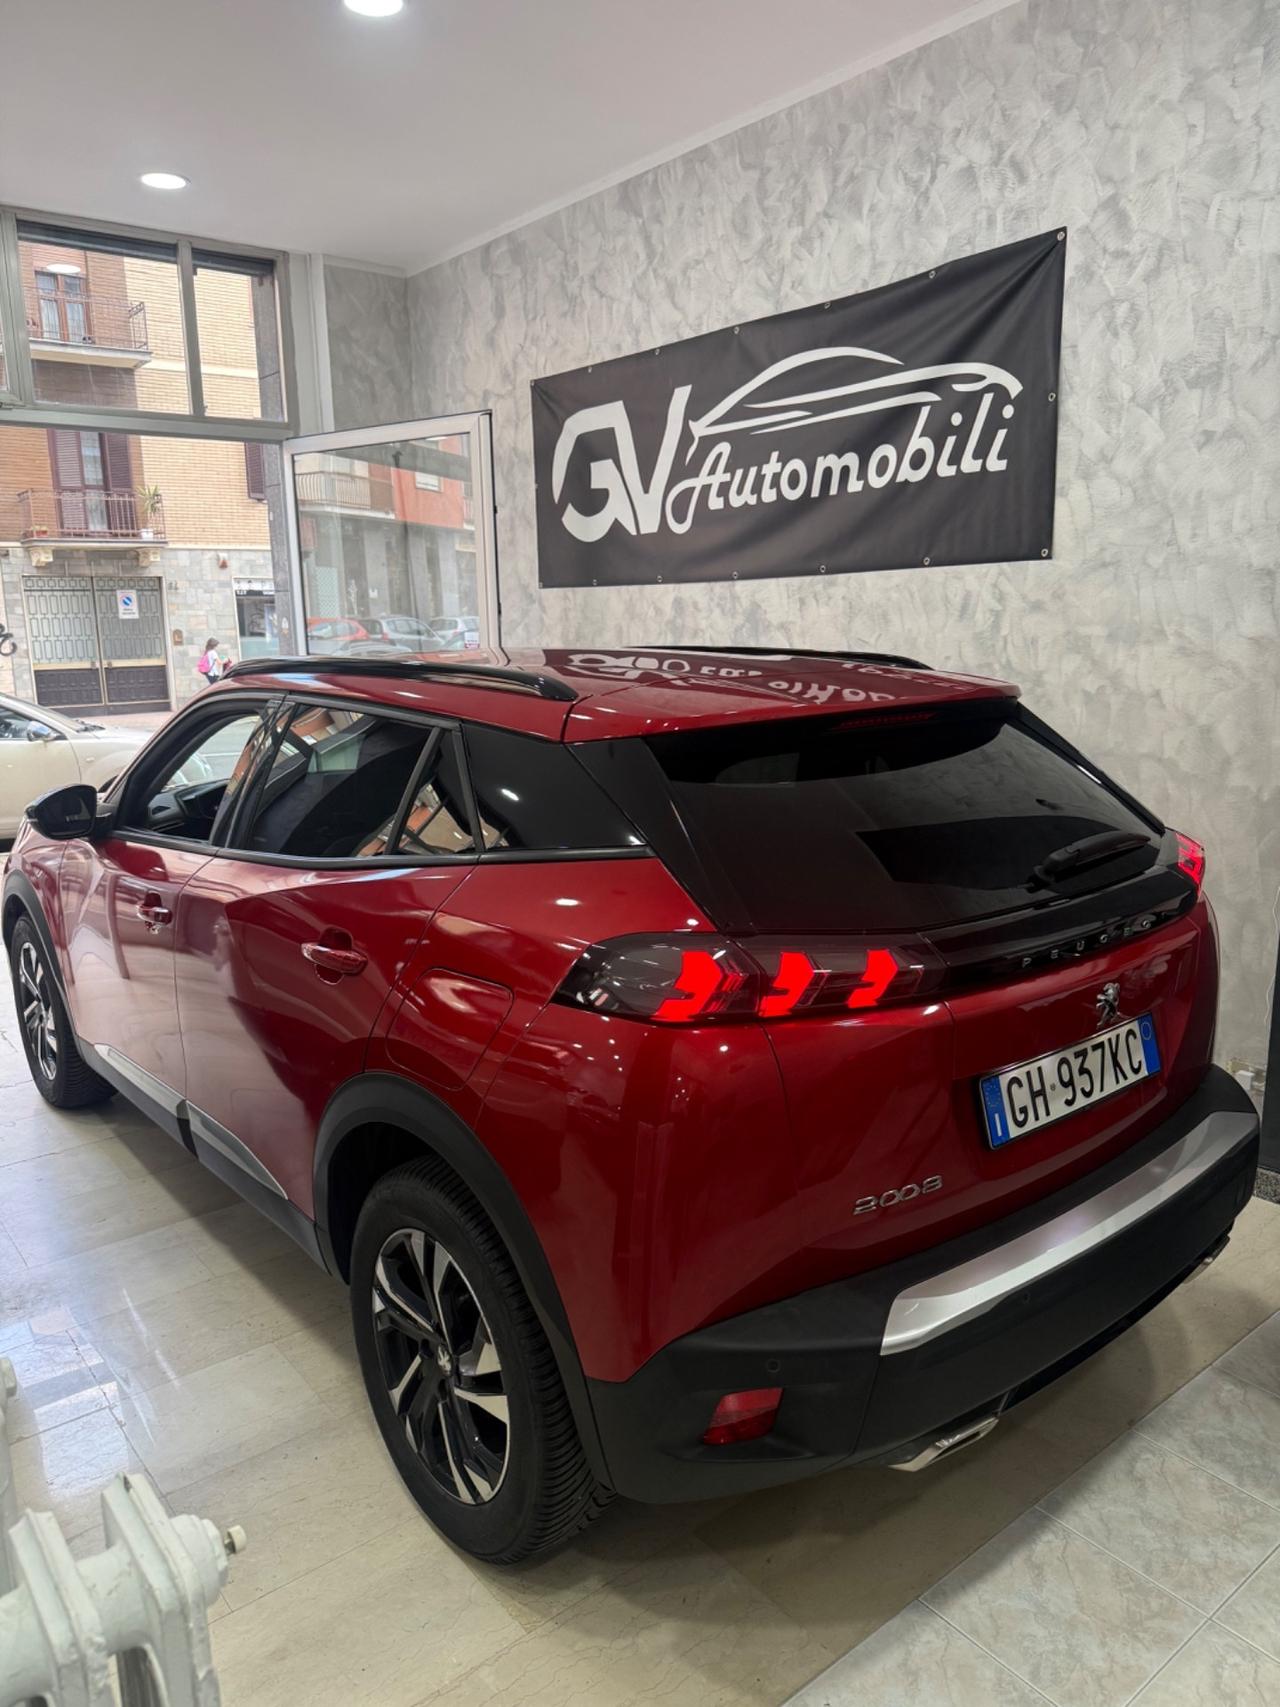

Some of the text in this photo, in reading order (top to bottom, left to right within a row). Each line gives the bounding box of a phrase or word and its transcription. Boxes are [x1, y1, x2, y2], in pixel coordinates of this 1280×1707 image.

[552, 385, 1015, 542] GV Automobili
[1022, 911, 1168, 968] PEUGEOT
[853, 1175, 943, 1215] 2008
